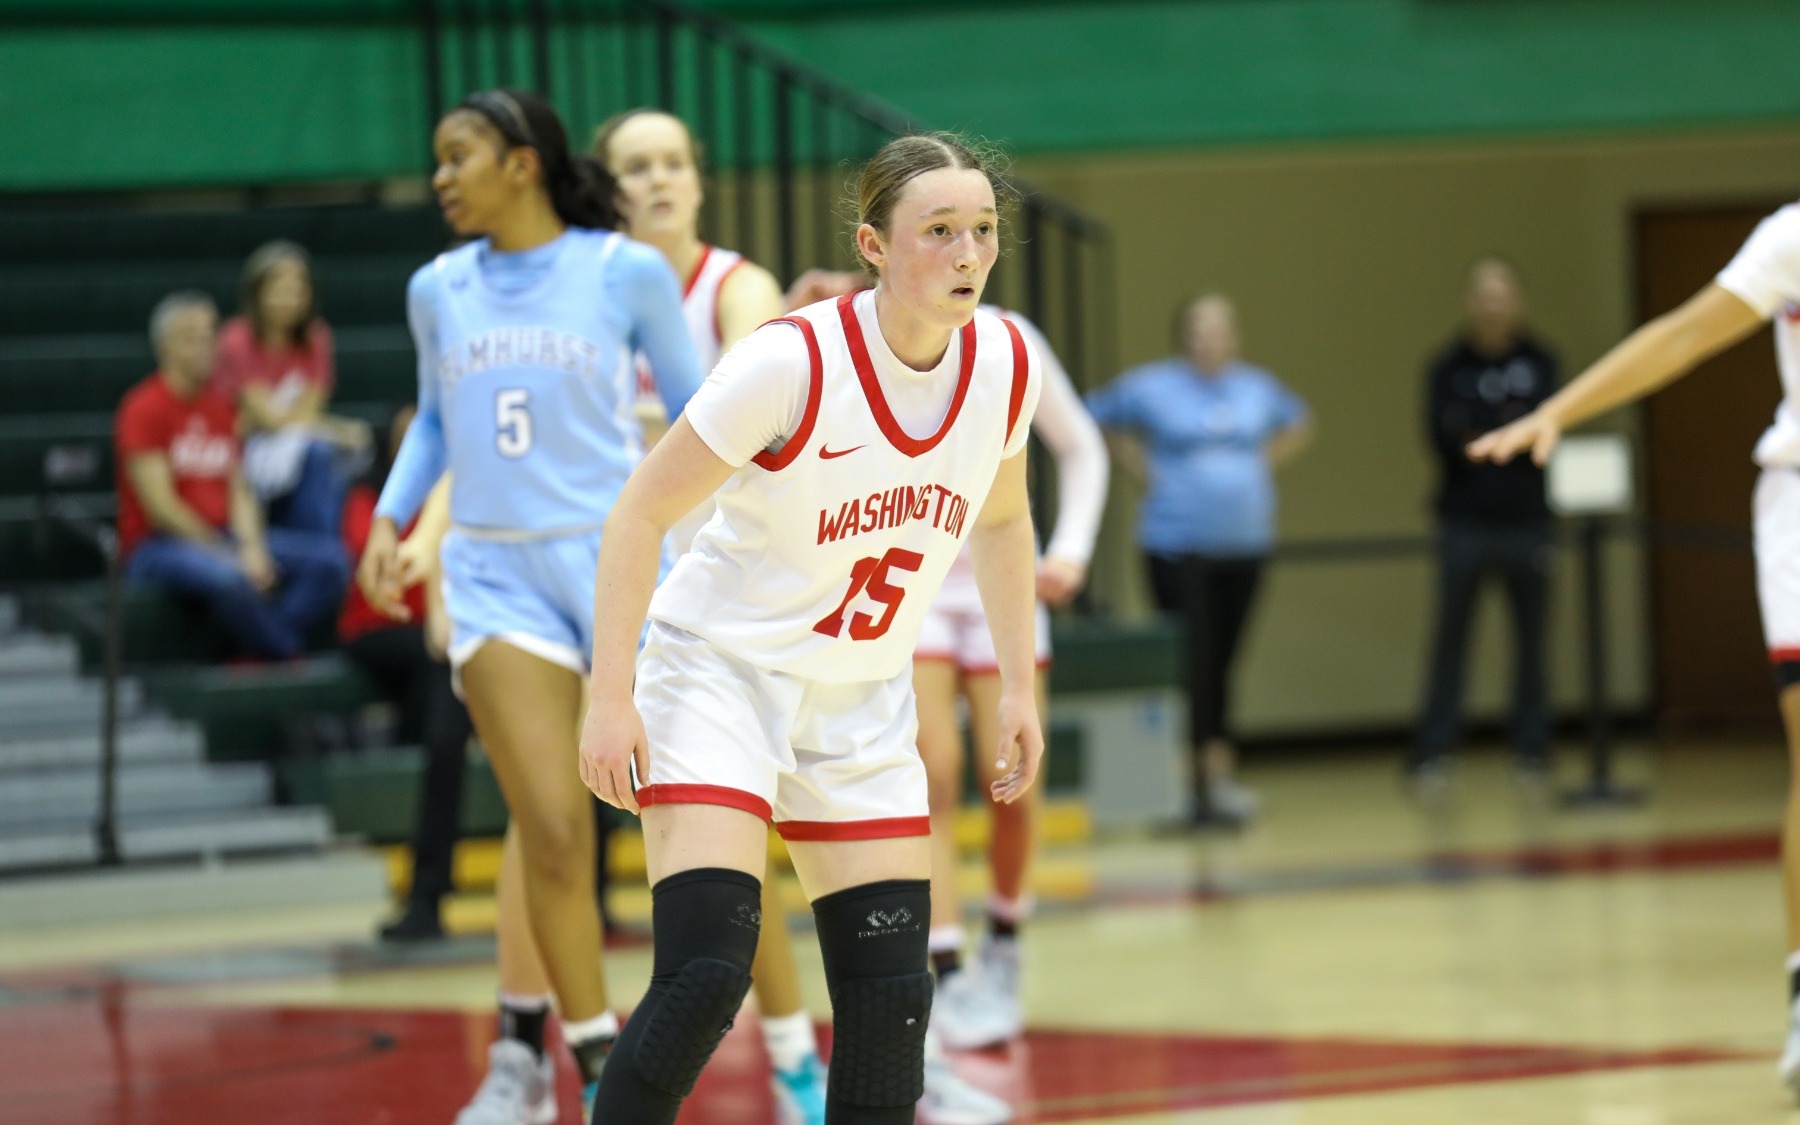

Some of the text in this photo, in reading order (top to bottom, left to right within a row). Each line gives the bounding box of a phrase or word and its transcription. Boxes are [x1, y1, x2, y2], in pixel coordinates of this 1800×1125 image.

[496, 388, 533, 458] 5
[817, 484, 969, 545] WASHINGTON
[812, 547, 924, 641] 15
